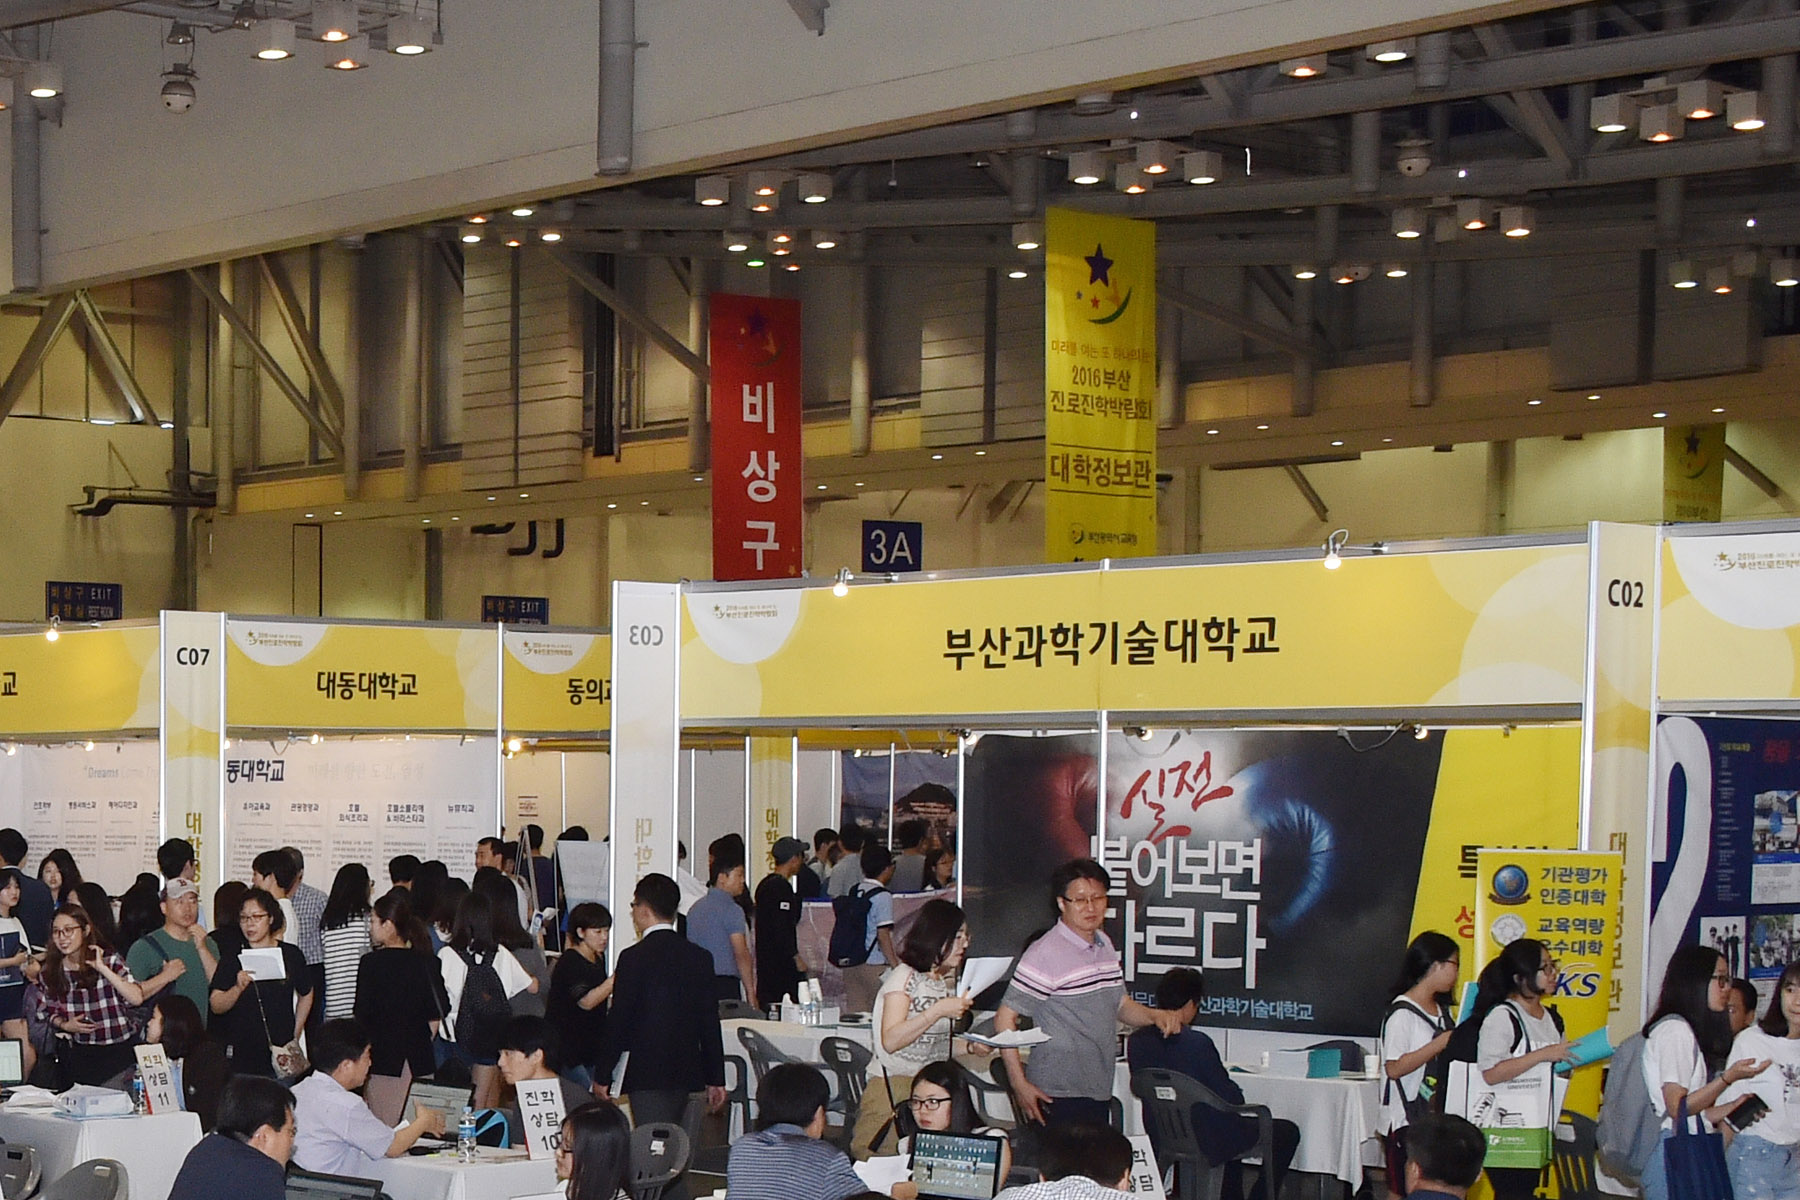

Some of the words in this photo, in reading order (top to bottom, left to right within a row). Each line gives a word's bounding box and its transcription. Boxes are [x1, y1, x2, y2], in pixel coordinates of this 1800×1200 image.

[1050, 390, 1153, 421] 진로진학박람회
[741, 380, 781, 571] 비상구
[1050, 452, 1151, 489] 대학정보관
[869, 529, 914, 566] 3A
[91, 587, 112, 600] EXIT
[1608, 579, 1644, 608] C02
[521, 601, 540, 613] EXIT
[943, 614, 1281, 672] 부산과학기술대학교
[176, 647, 211, 667] C07
[316, 671, 419, 700] 대동대학교
[225, 759, 286, 784] 동대학교
[1120, 751, 1234, 850] 실전
[1540, 867, 1609, 885] 기관평가
[1539, 887, 1608, 906] 인증대학
[1537, 916, 1606, 936] 교육역량
[1553, 971, 1602, 997] KS
[142, 1053, 164, 1069] 진학
[148, 1071, 170, 1087] 상담
[157, 1091, 171, 1106] 11
[524, 1089, 556, 1107] 진학
[530, 1111, 559, 1128] 상담
[541, 1134, 559, 1151] 10
